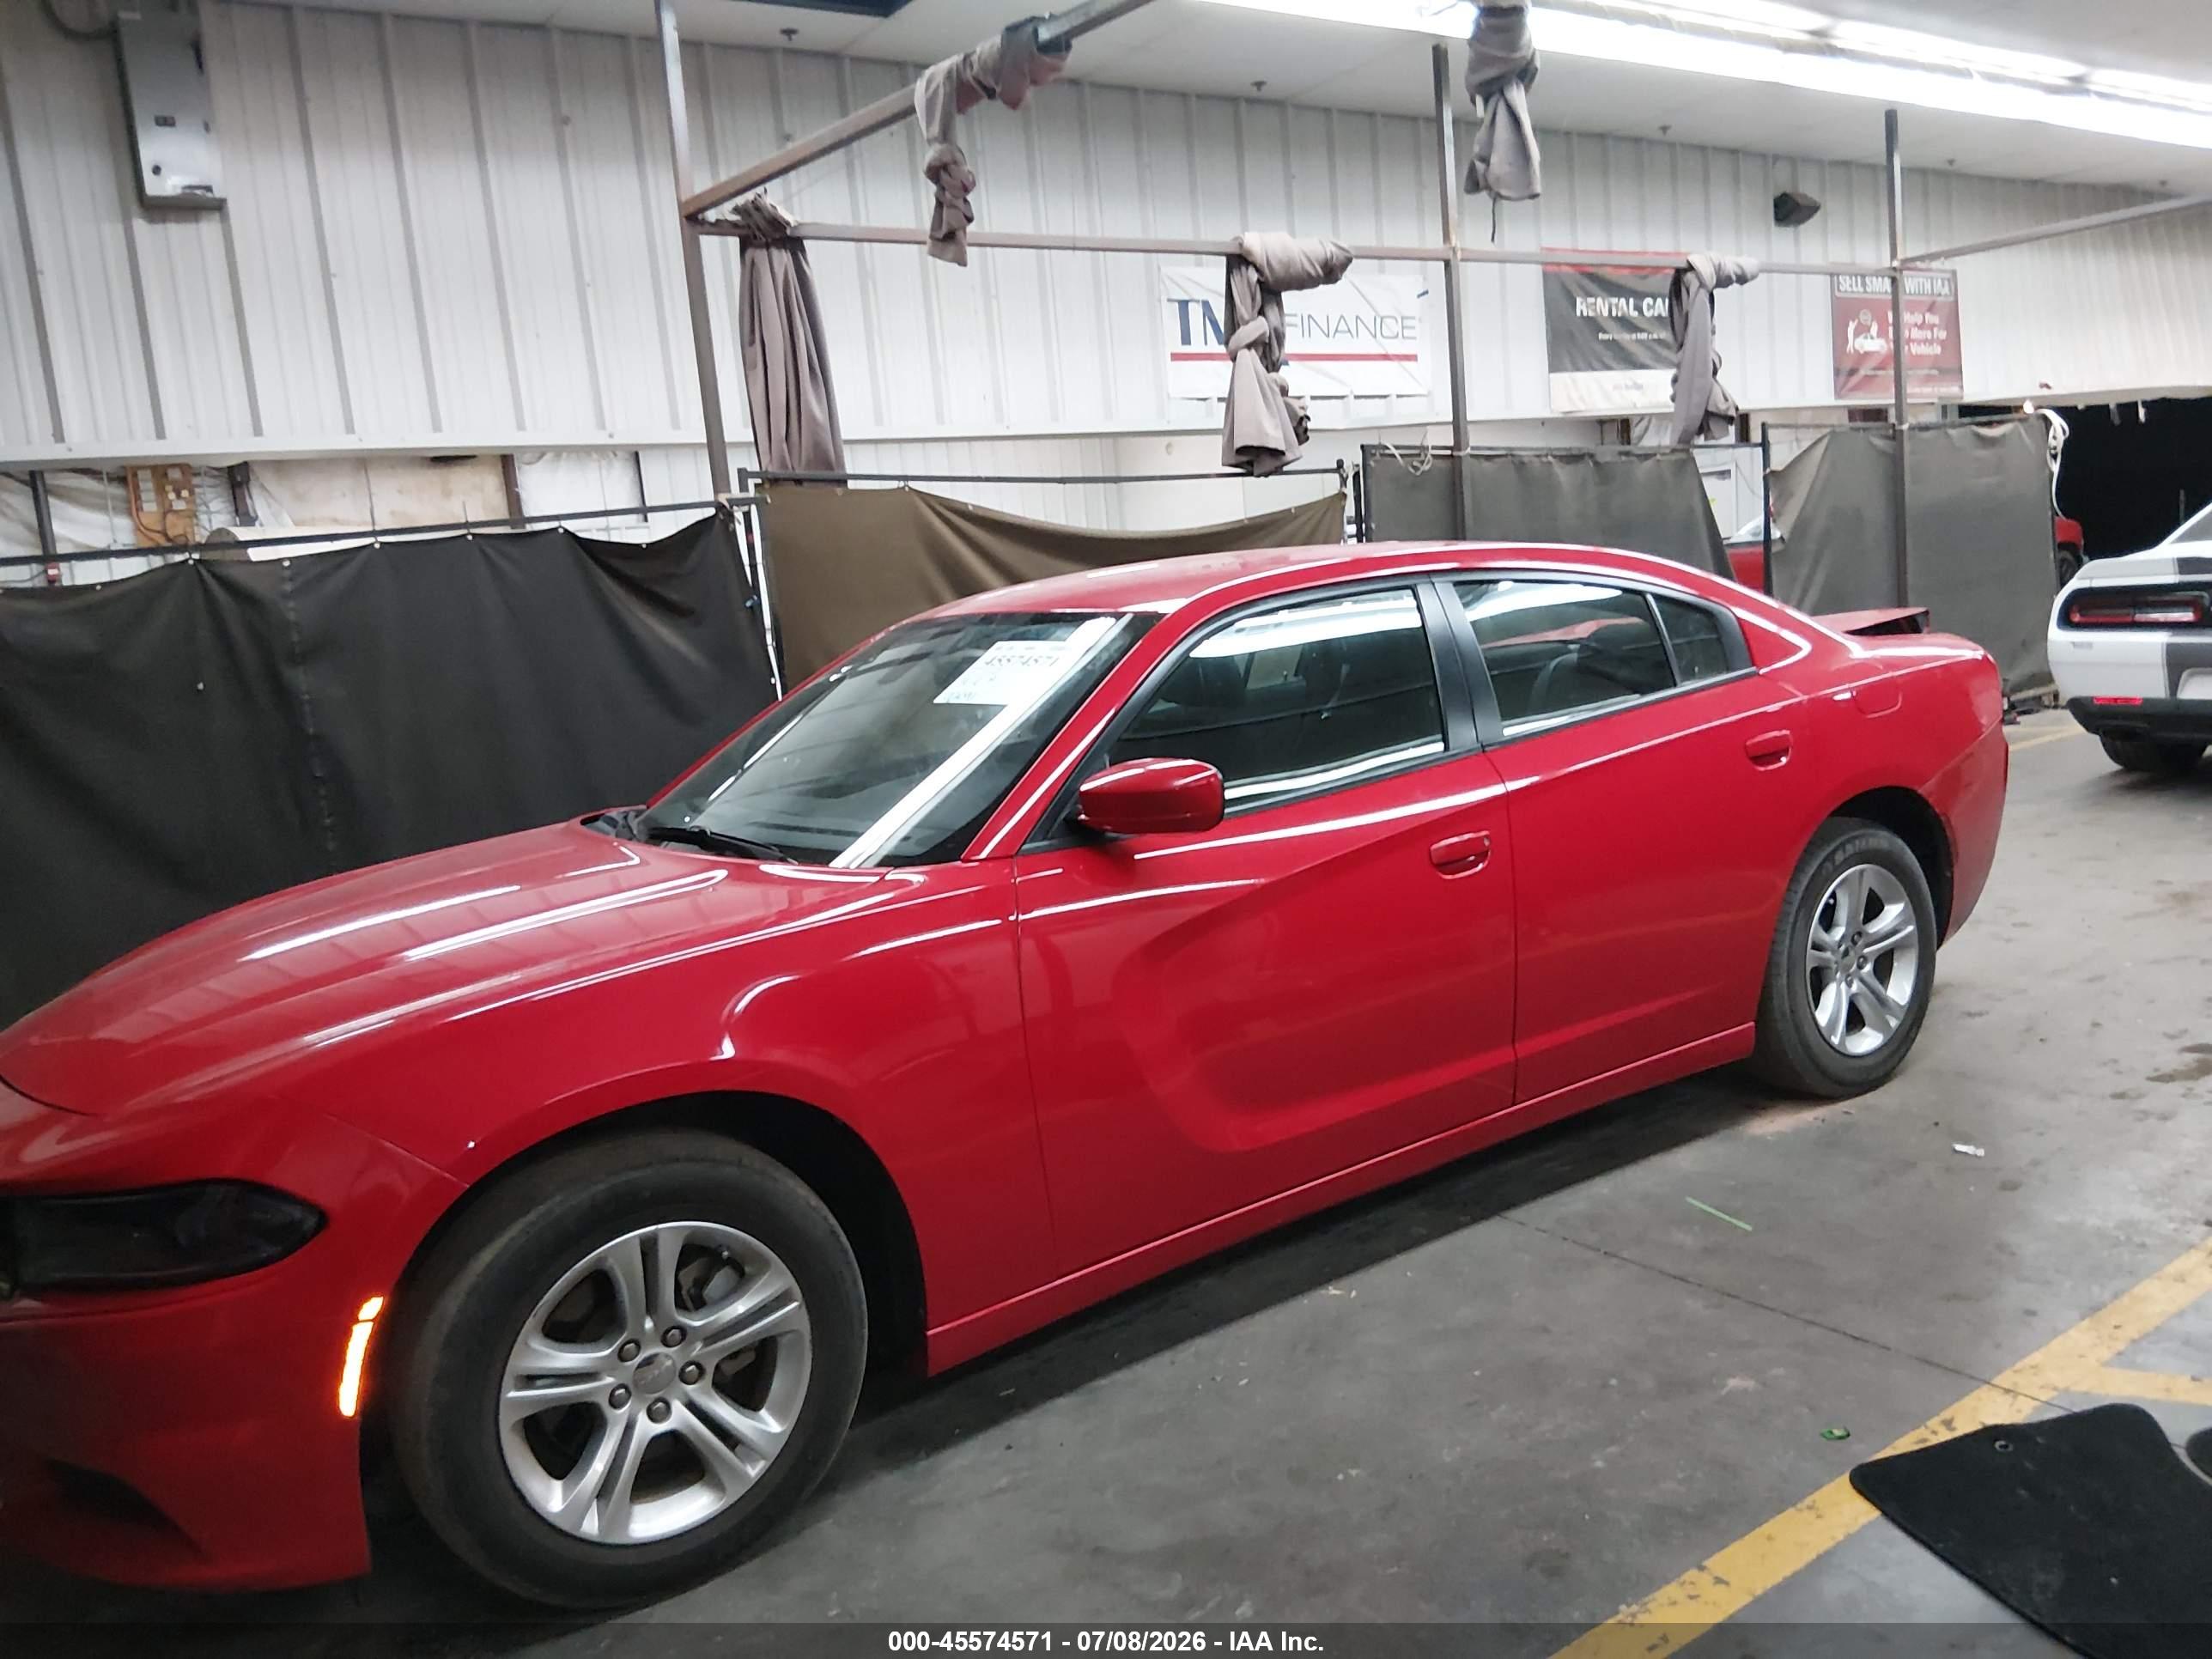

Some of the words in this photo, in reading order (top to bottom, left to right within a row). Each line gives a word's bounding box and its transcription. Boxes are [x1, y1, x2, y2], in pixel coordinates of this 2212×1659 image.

[1838, 274, 1864, 293] SELL
[1865, 275, 1892, 294] SMA
[1904, 276, 1931, 295] WITH
[1932, 277, 1951, 295] IAA
[1576, 295, 1638, 317] RENTAL
